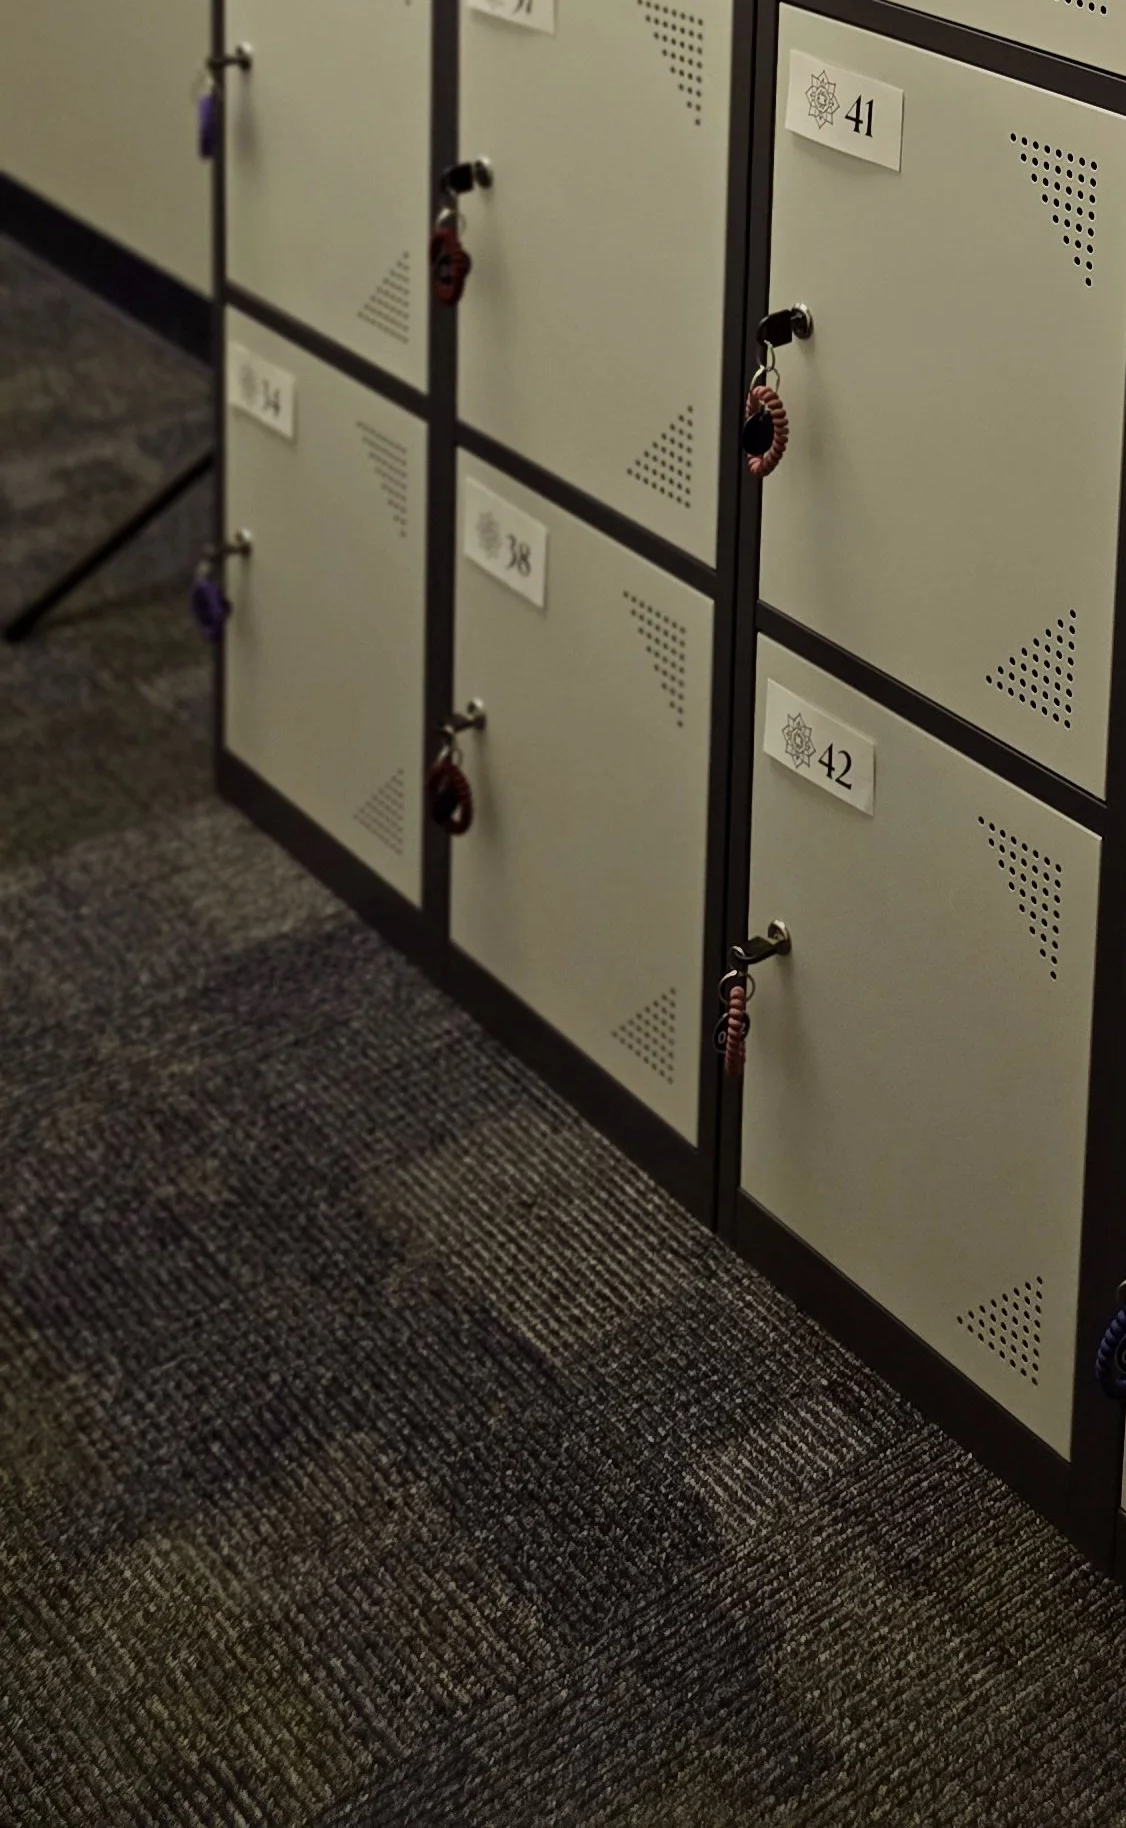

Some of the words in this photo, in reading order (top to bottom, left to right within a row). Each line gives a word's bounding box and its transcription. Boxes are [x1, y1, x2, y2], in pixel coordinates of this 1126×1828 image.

[844, 94, 874, 138] 41
[507, 534, 532, 577] 38
[817, 743, 853, 790] 42
